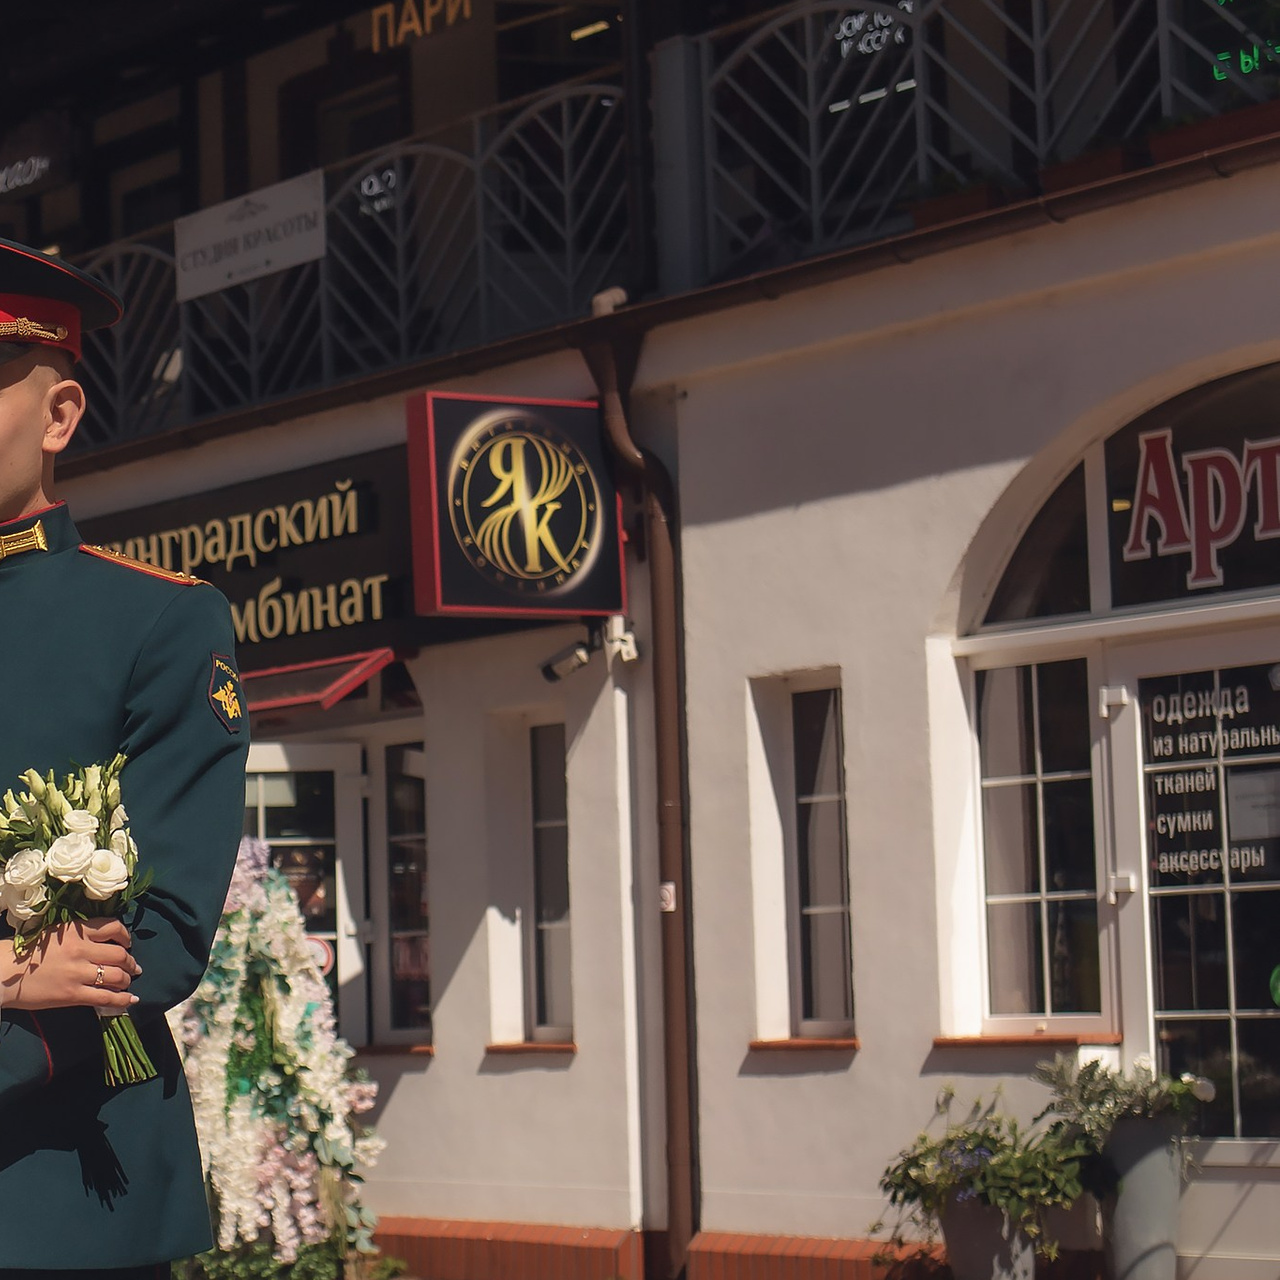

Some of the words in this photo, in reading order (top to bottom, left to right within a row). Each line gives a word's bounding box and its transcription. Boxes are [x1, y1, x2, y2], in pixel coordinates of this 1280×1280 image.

[104, 477, 359, 574] инградский
[230, 573, 390, 644] мбинат
[1152, 685, 1250, 725] одежда
[1153, 735, 1173, 757] из
[1154, 766, 1216, 796] тканей
[1156, 810, 1214, 839] сумки
